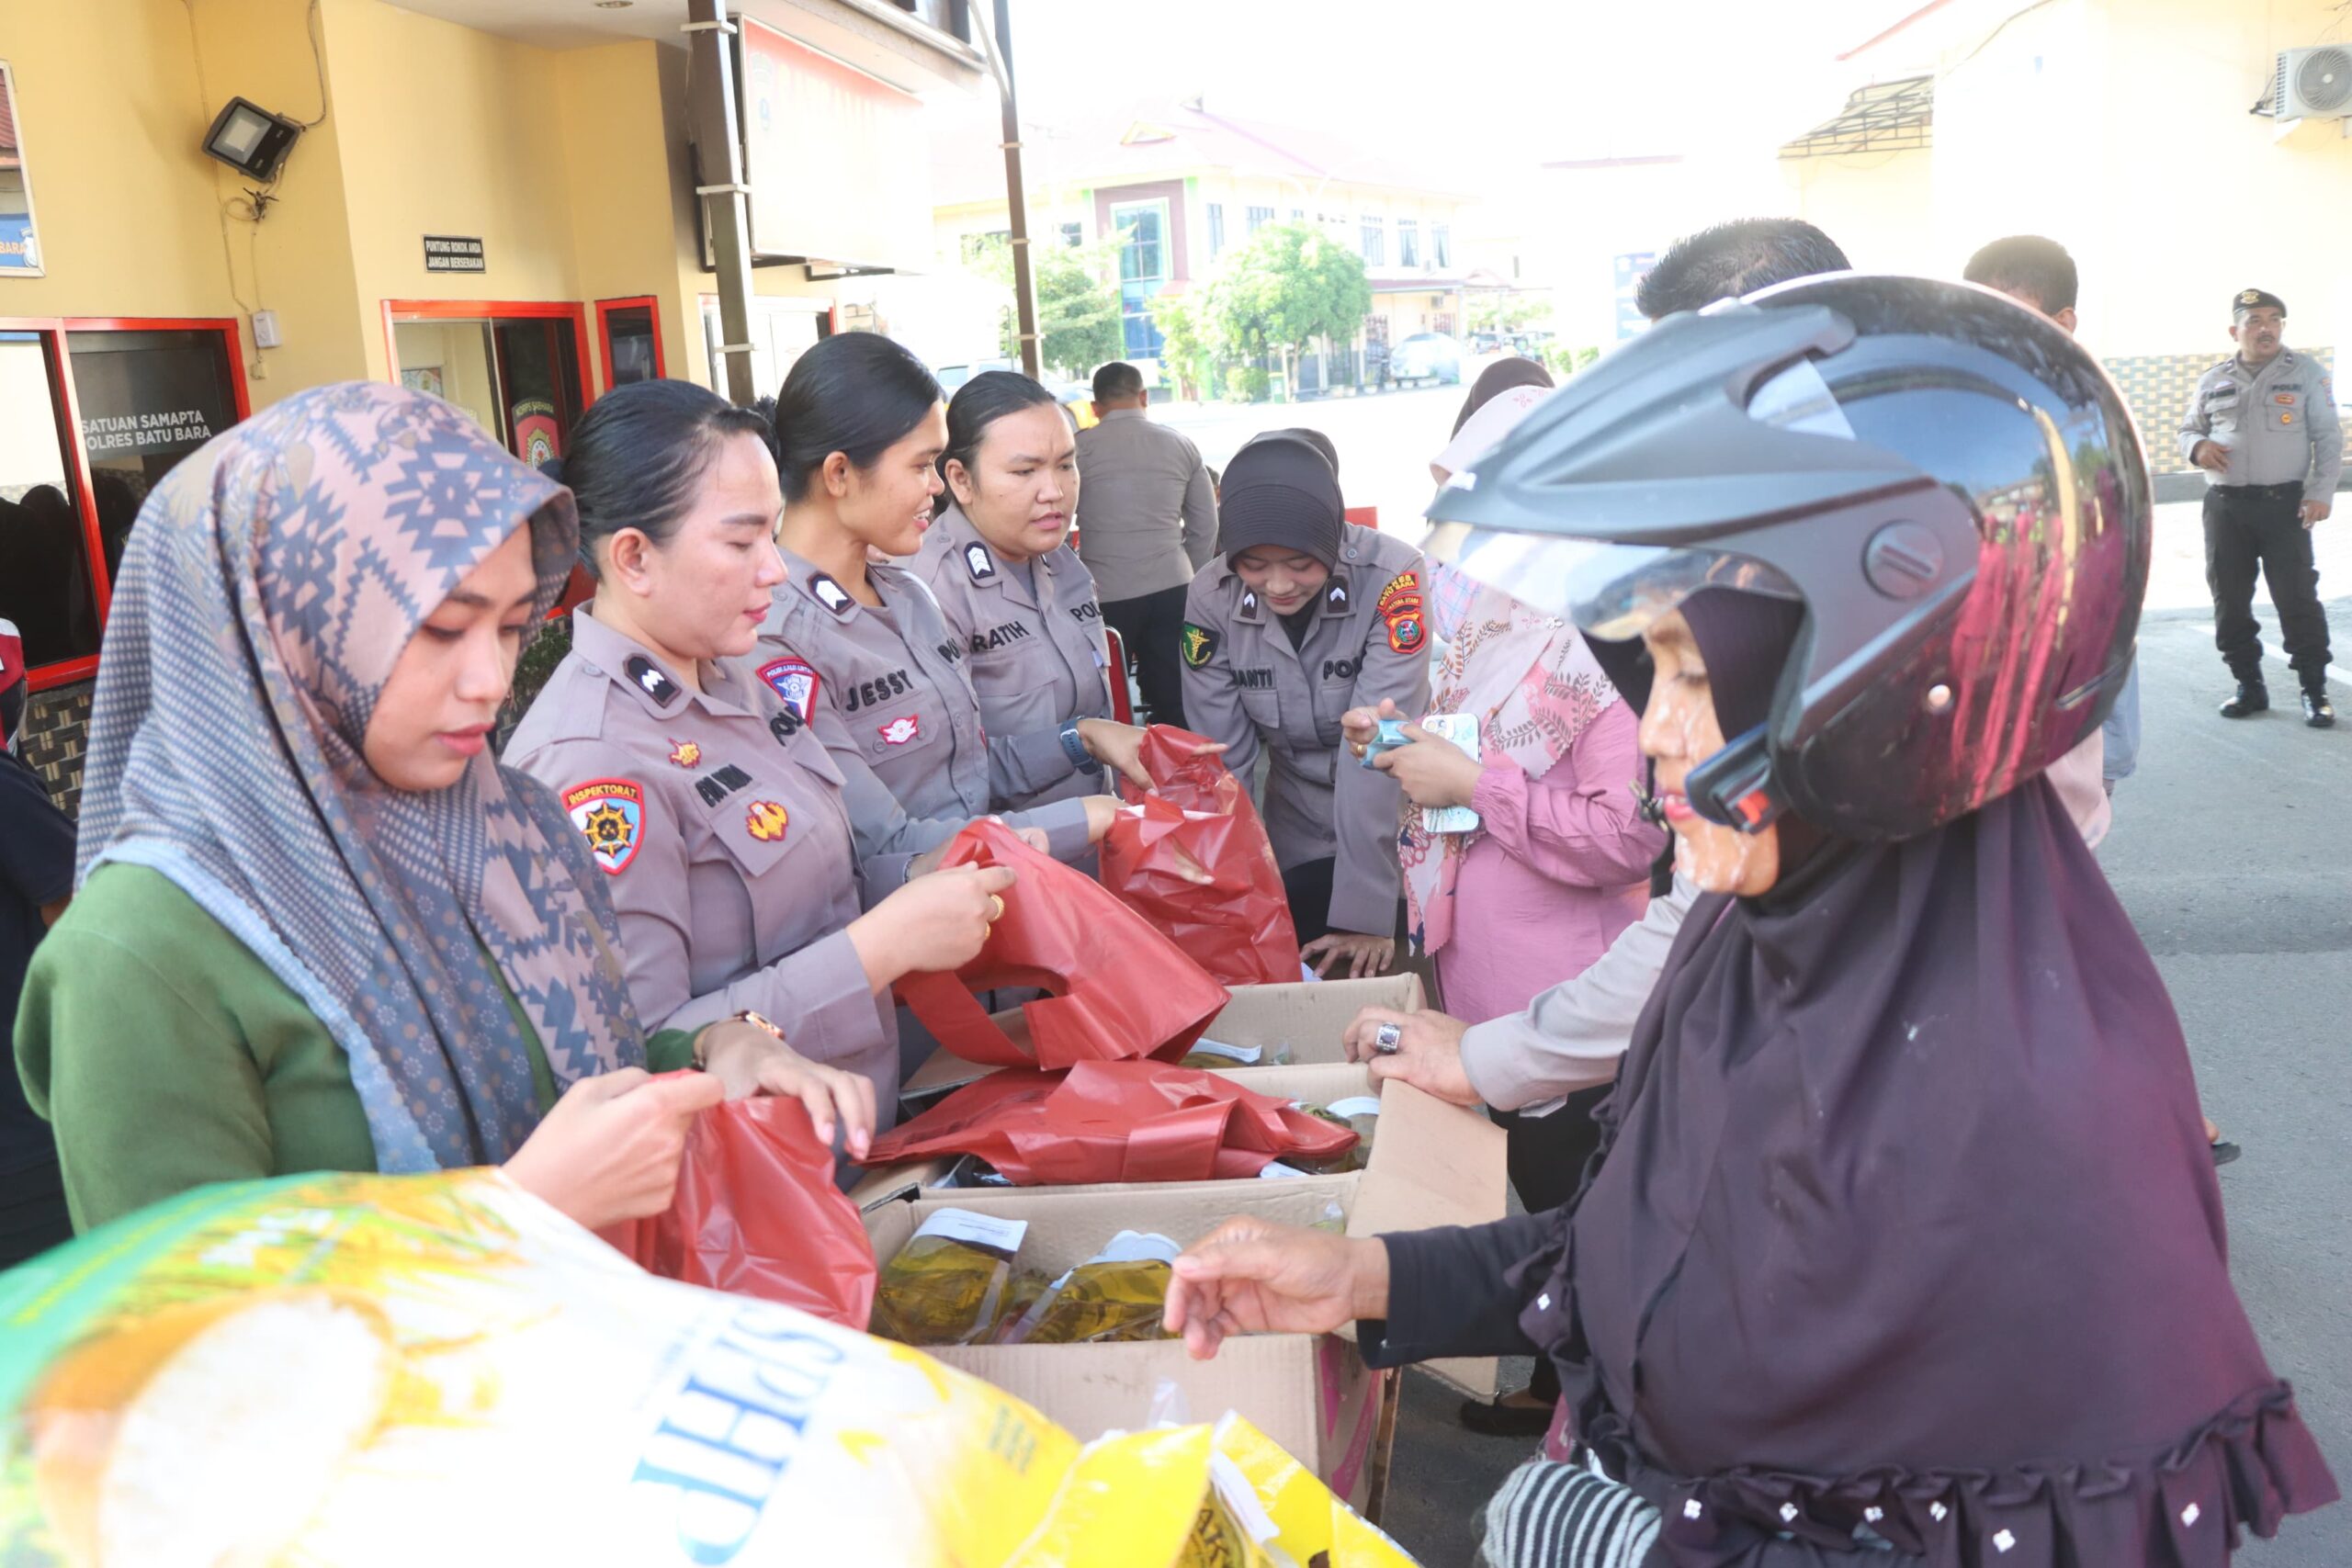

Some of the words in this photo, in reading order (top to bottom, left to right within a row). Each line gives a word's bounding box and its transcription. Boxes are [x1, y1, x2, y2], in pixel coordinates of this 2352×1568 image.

[81, 416, 138, 434] SATUAN
[141, 411, 204, 428] SAMAPTA
[85, 432, 133, 450] OLRES
[135, 429, 172, 446] BATU
[175, 425, 212, 442] BARA
[1069, 601, 1102, 622] POL
[970, 621, 1030, 653] RATIH
[846, 669, 913, 712] JESSY
[568, 784, 638, 806] INSPEKTORAT
